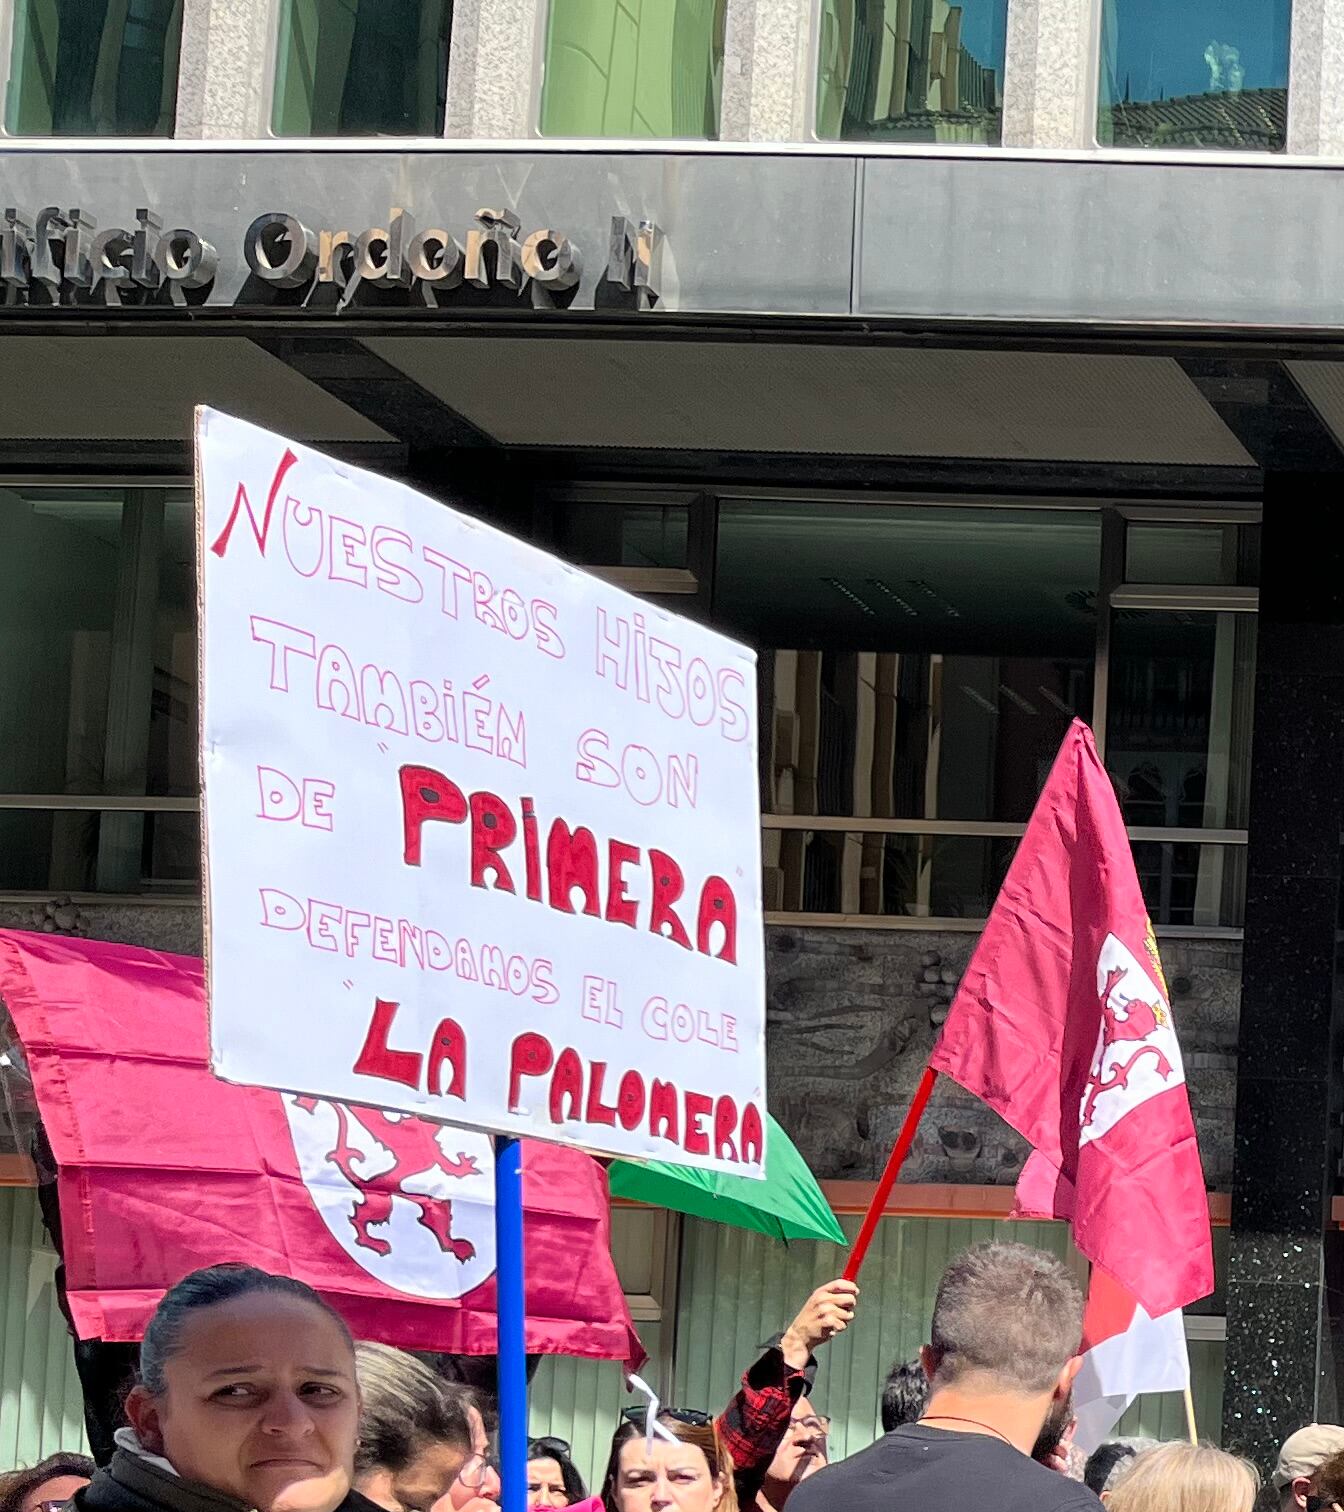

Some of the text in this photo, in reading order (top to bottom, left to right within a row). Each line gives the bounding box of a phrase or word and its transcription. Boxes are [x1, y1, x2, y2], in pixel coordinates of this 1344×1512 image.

[243, 206, 578, 289] Ordoño
[211, 448, 566, 660] NUESTROS
[257, 764, 336, 832] DE
[576, 728, 699, 810] SON
[260, 887, 740, 1052] DEFENDAMOS EL COLE
